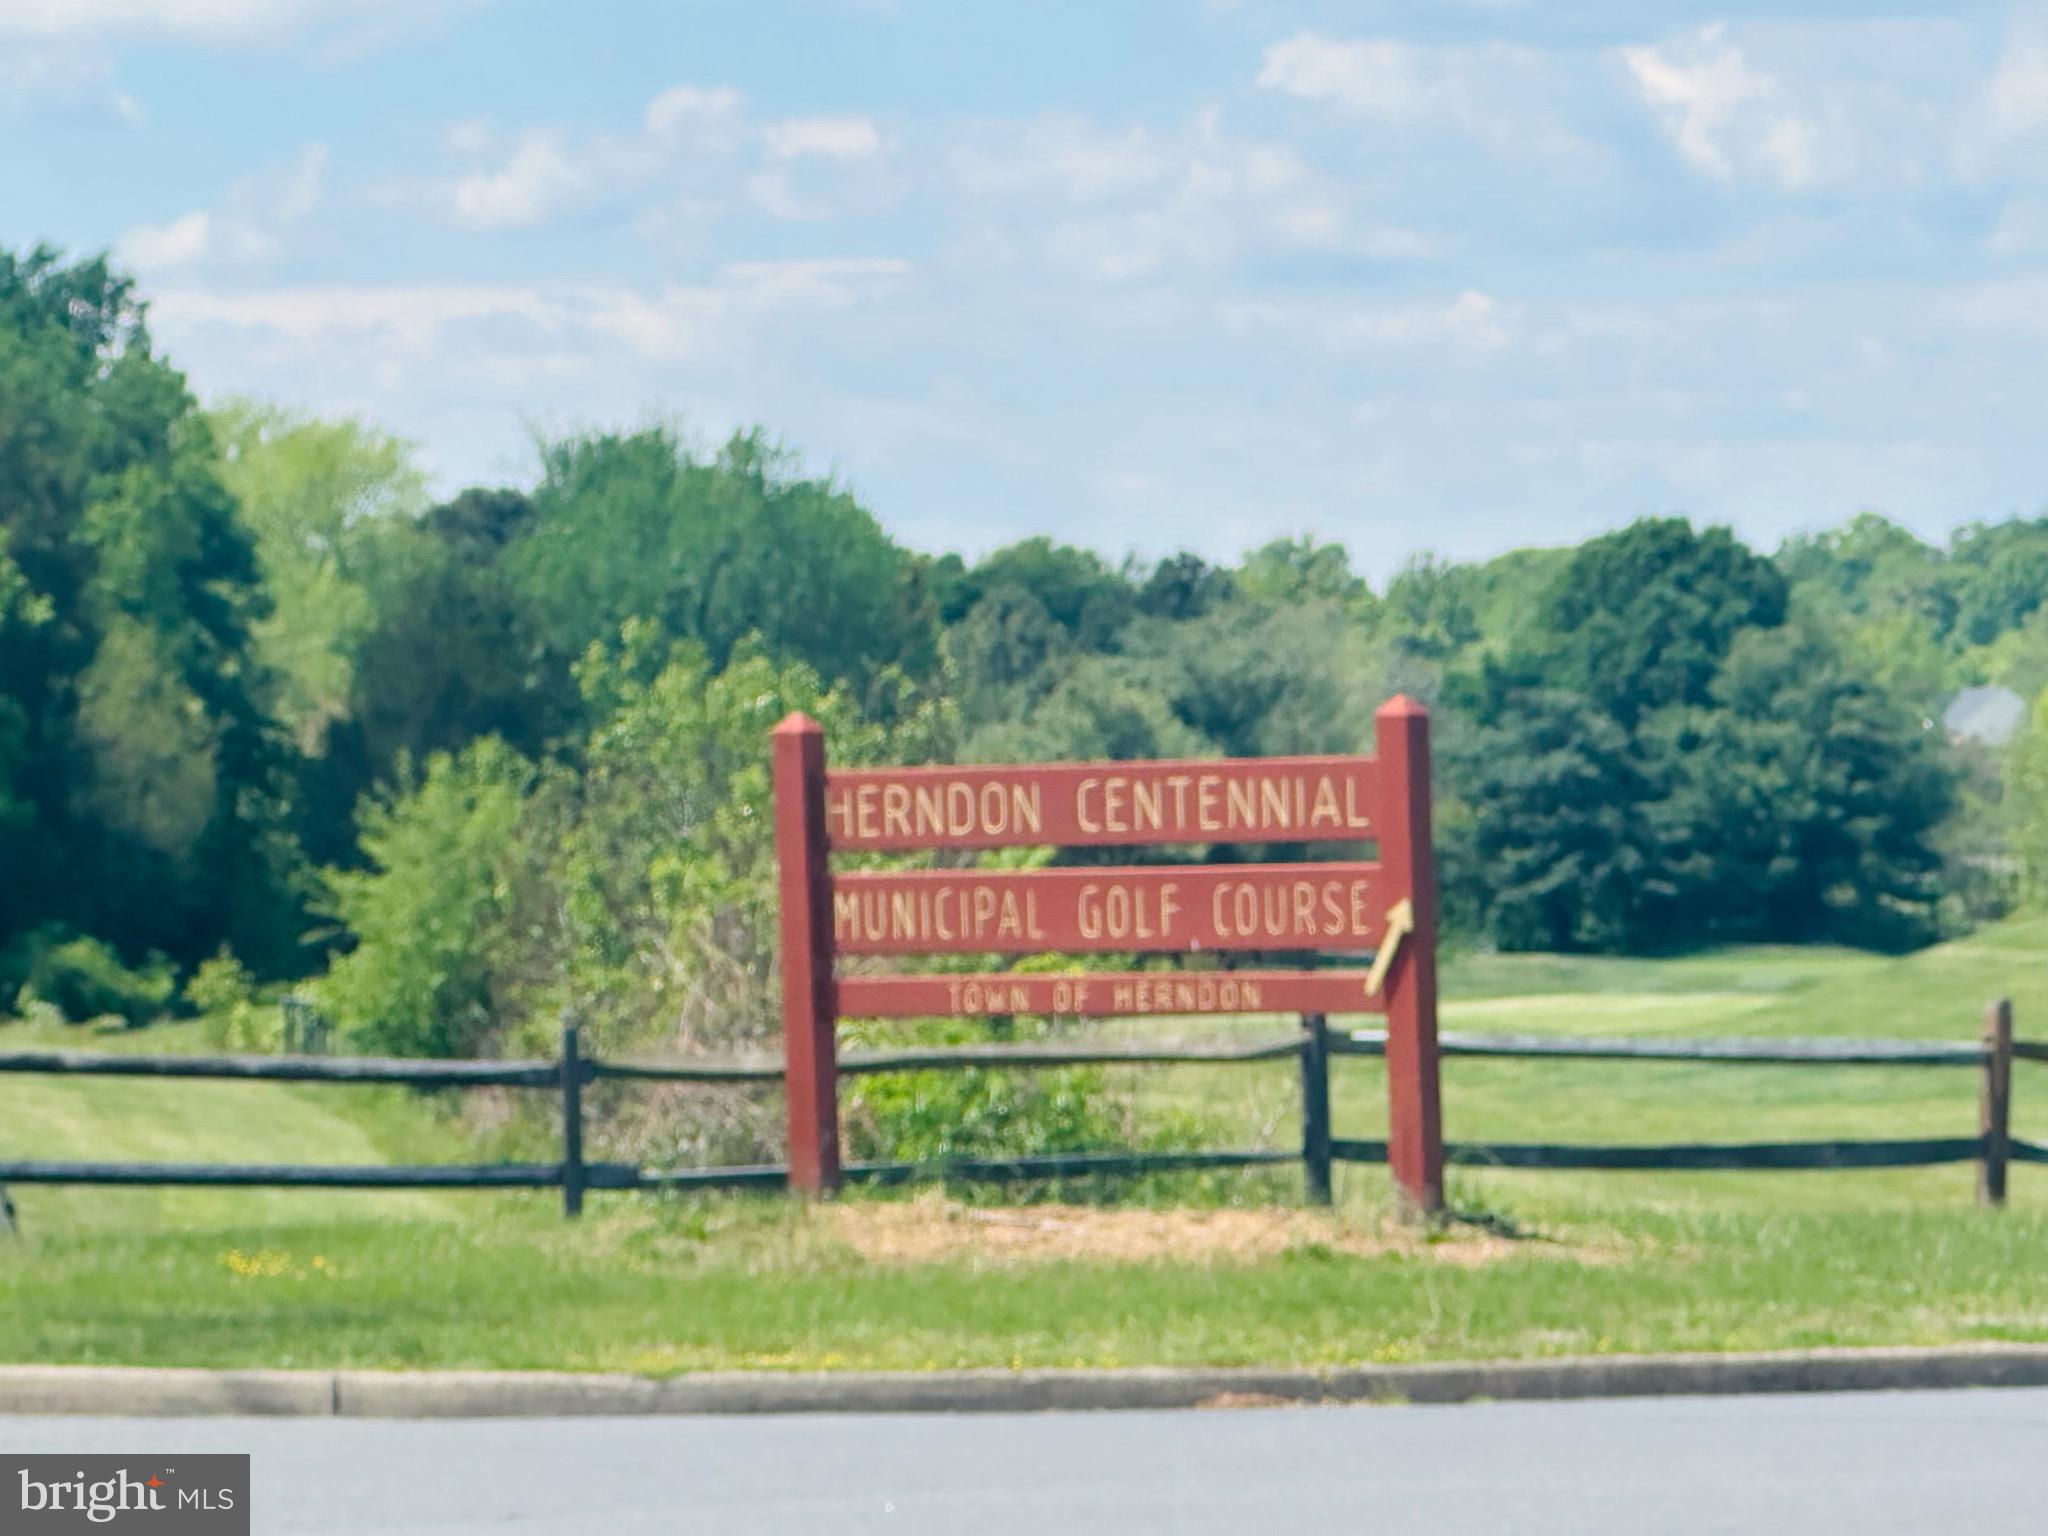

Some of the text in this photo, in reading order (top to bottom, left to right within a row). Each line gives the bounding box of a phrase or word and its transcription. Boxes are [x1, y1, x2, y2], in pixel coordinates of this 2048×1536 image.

[827, 774, 1371, 839] HERNDON CENTENNIAL
[834, 880, 1372, 942] MUNICIPAL GOLF COURSE
[948, 982, 1261, 1013] TOWN OF HERNDON
